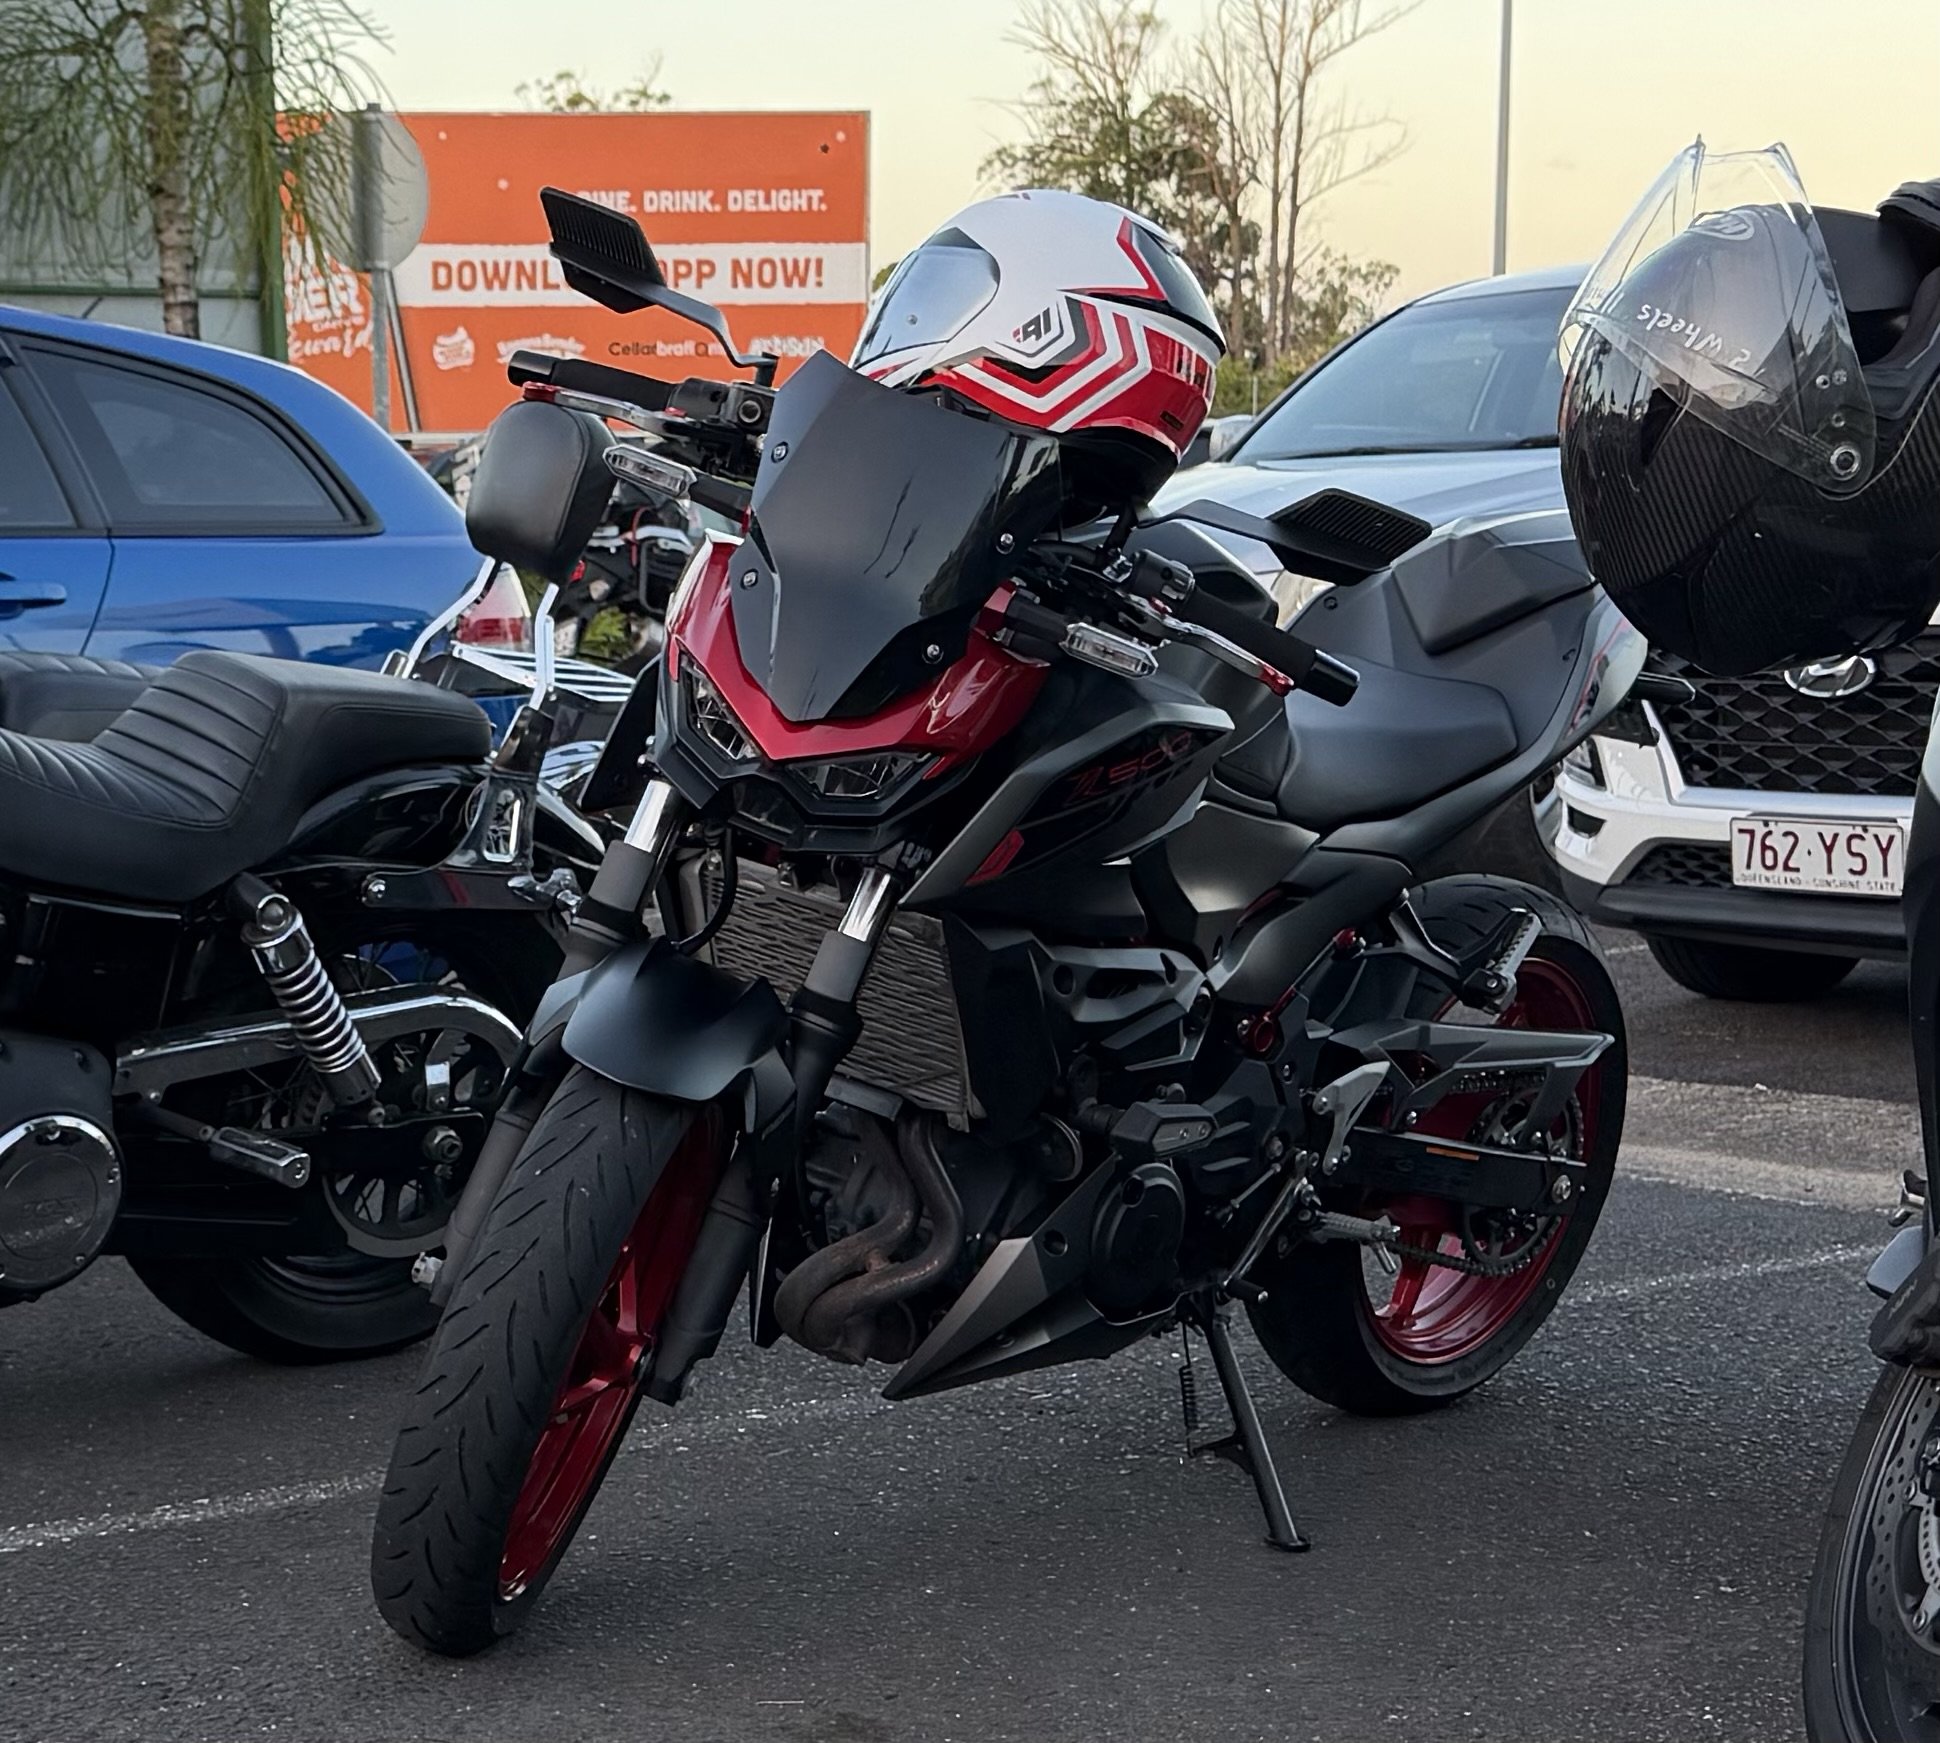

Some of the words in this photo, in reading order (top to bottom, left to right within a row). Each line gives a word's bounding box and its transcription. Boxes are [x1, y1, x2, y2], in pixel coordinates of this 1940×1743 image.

[644, 190, 721, 213] DRINK.
[727, 189, 828, 212] DELIGHT.
[730, 257, 823, 289] NOW!
[1636, 303, 1723, 355] Wheels
